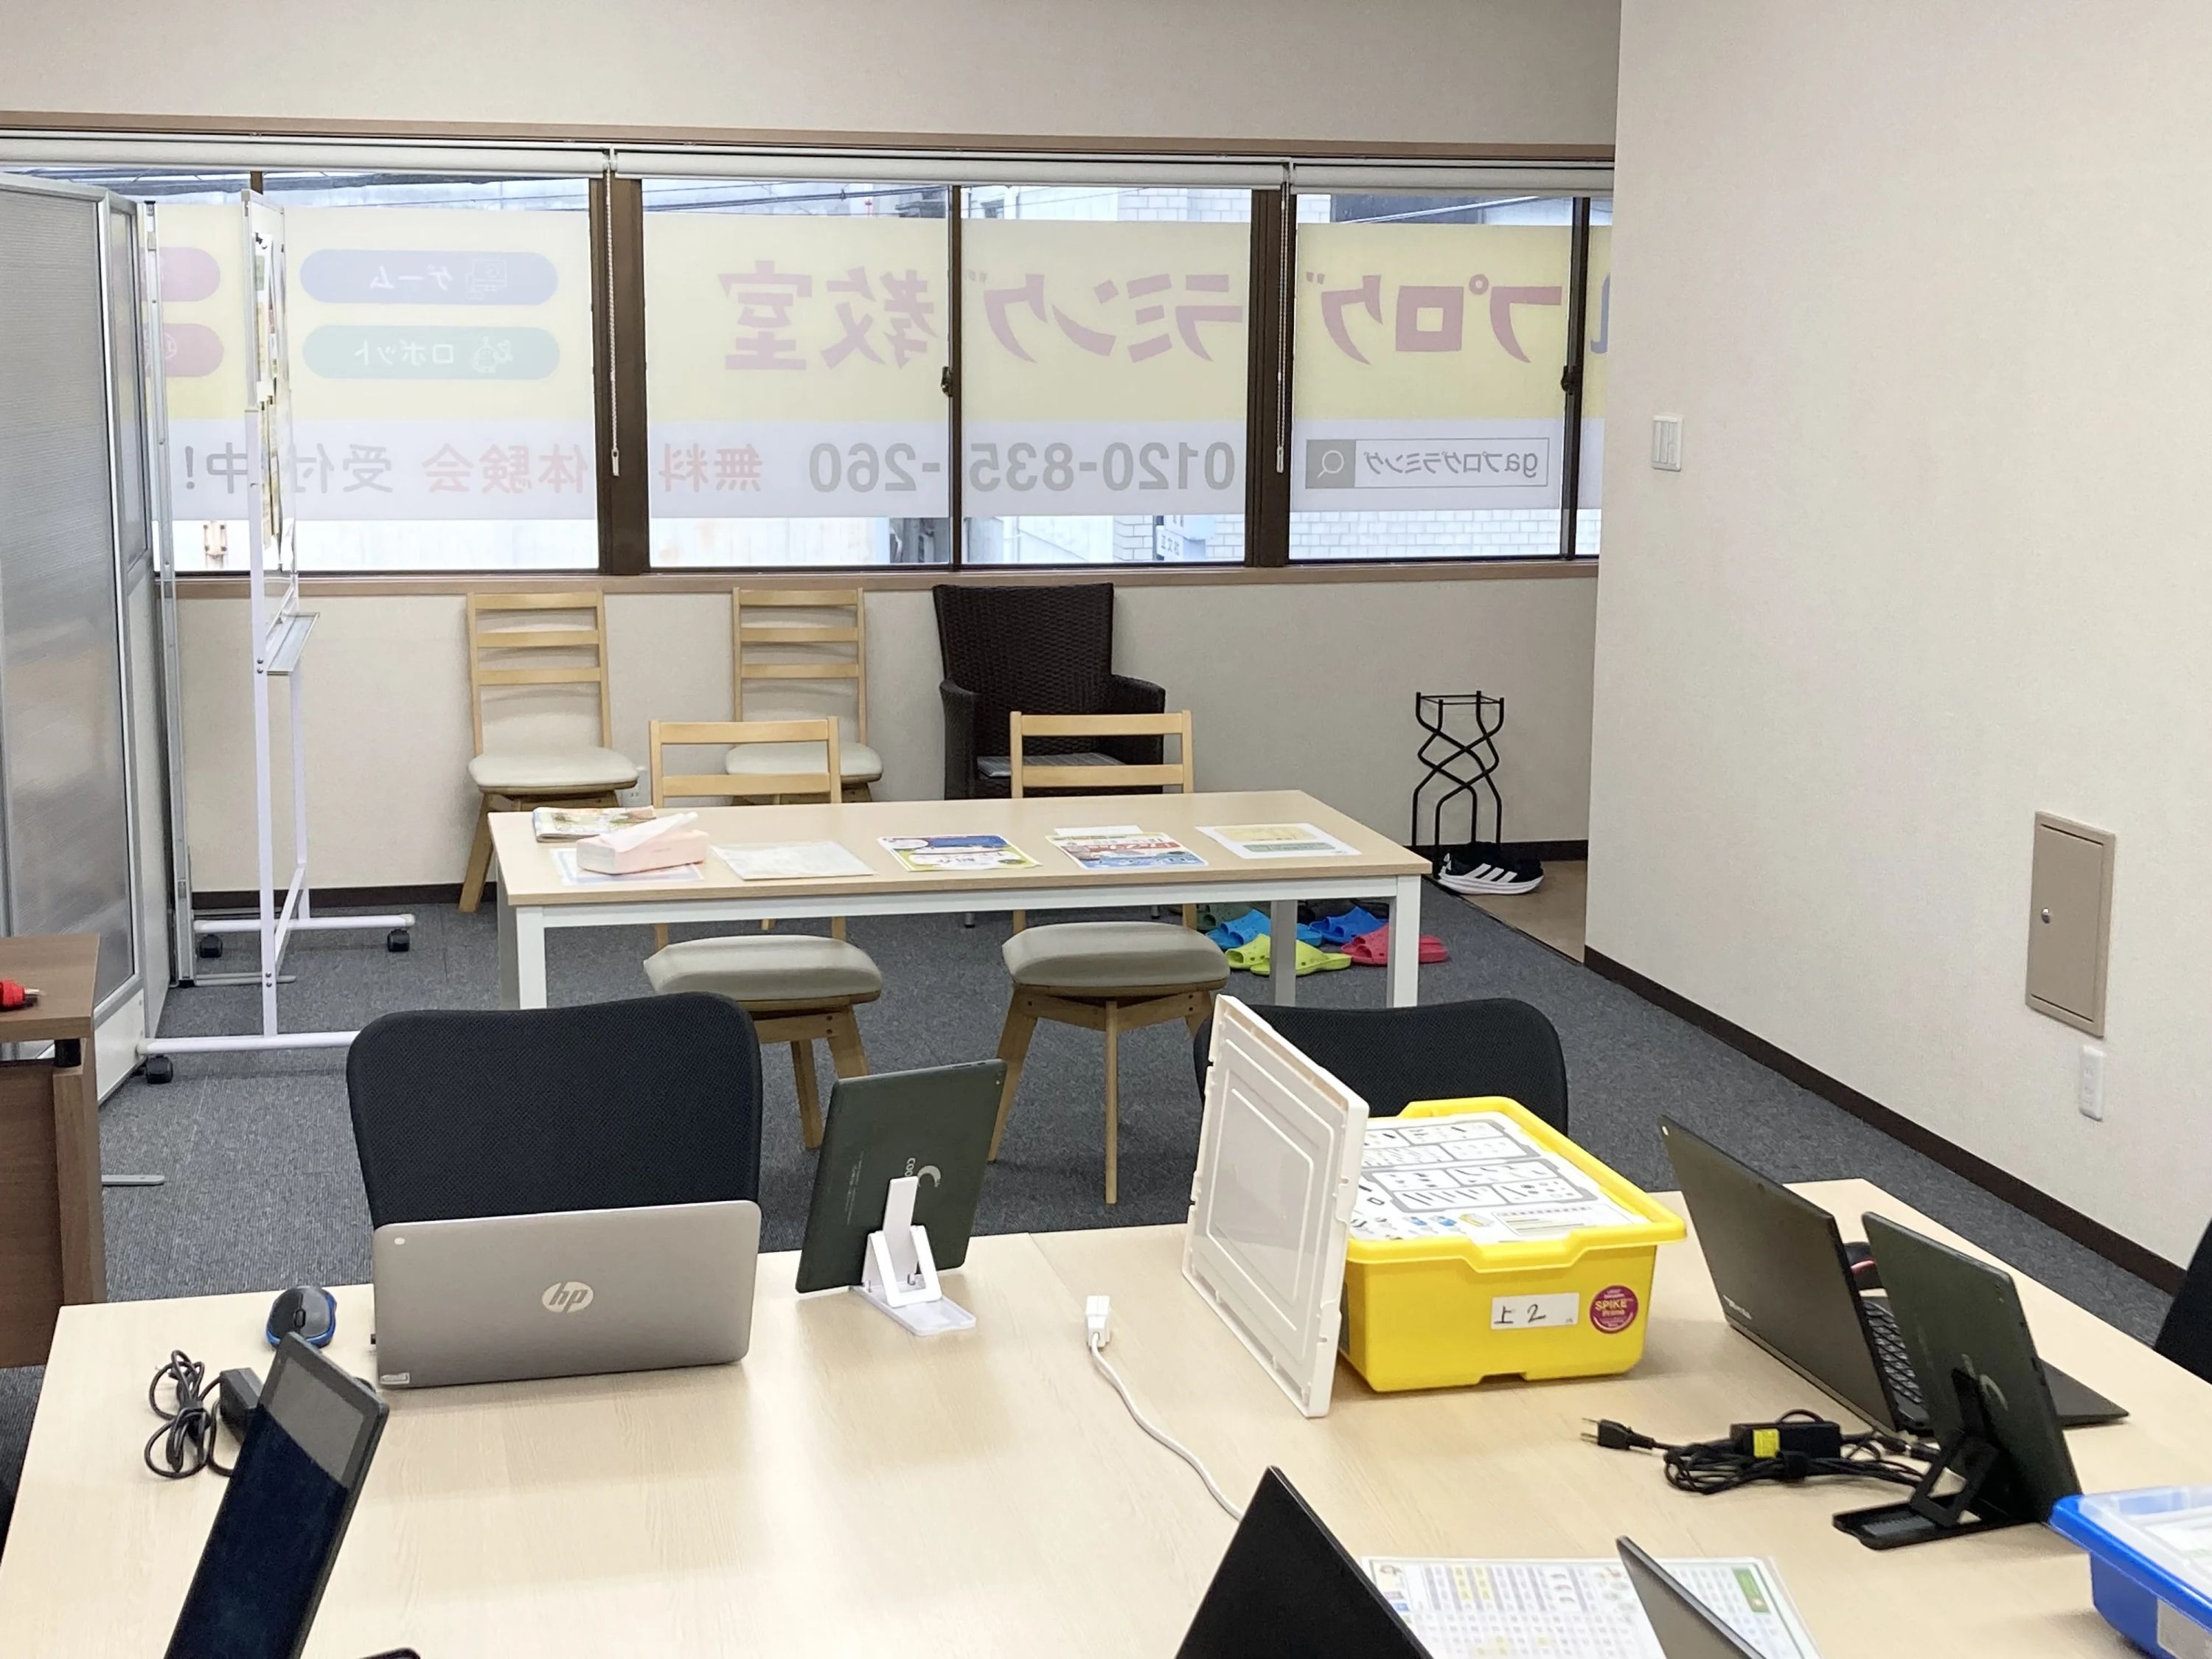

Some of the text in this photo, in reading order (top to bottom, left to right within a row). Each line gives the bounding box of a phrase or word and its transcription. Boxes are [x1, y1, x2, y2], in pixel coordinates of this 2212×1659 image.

[548, 1281, 588, 1313] hp
[1595, 1298, 1628, 1312] SPIKE
[1527, 1304, 1547, 1324] 2
